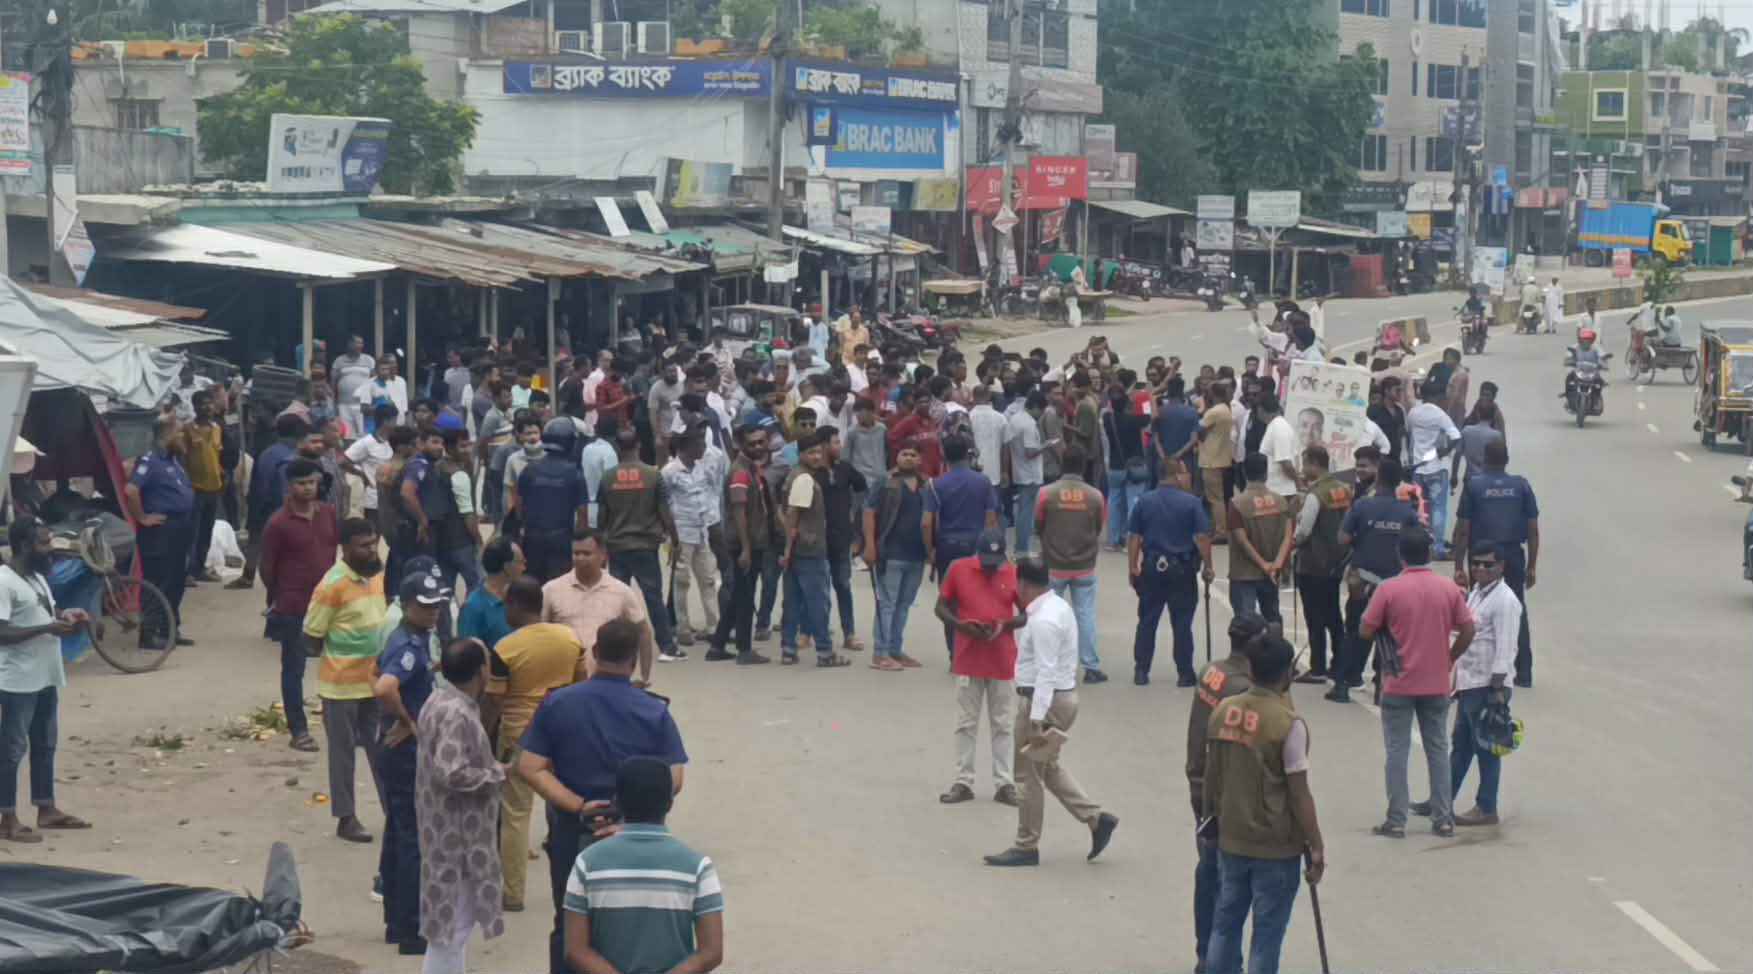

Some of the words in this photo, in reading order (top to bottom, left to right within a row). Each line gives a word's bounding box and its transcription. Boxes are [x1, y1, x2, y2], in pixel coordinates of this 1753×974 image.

[608, 65, 676, 90] ব্যাংক
[928, 80, 957, 101] BANK
[847, 123, 892, 152] BRAC
[895, 125, 937, 154] BANK
[1035, 164, 1077, 175] SINGER
[1485, 487, 1515, 498] POLICE
[1202, 665, 1226, 691] DB
[1224, 706, 1259, 733] DB
